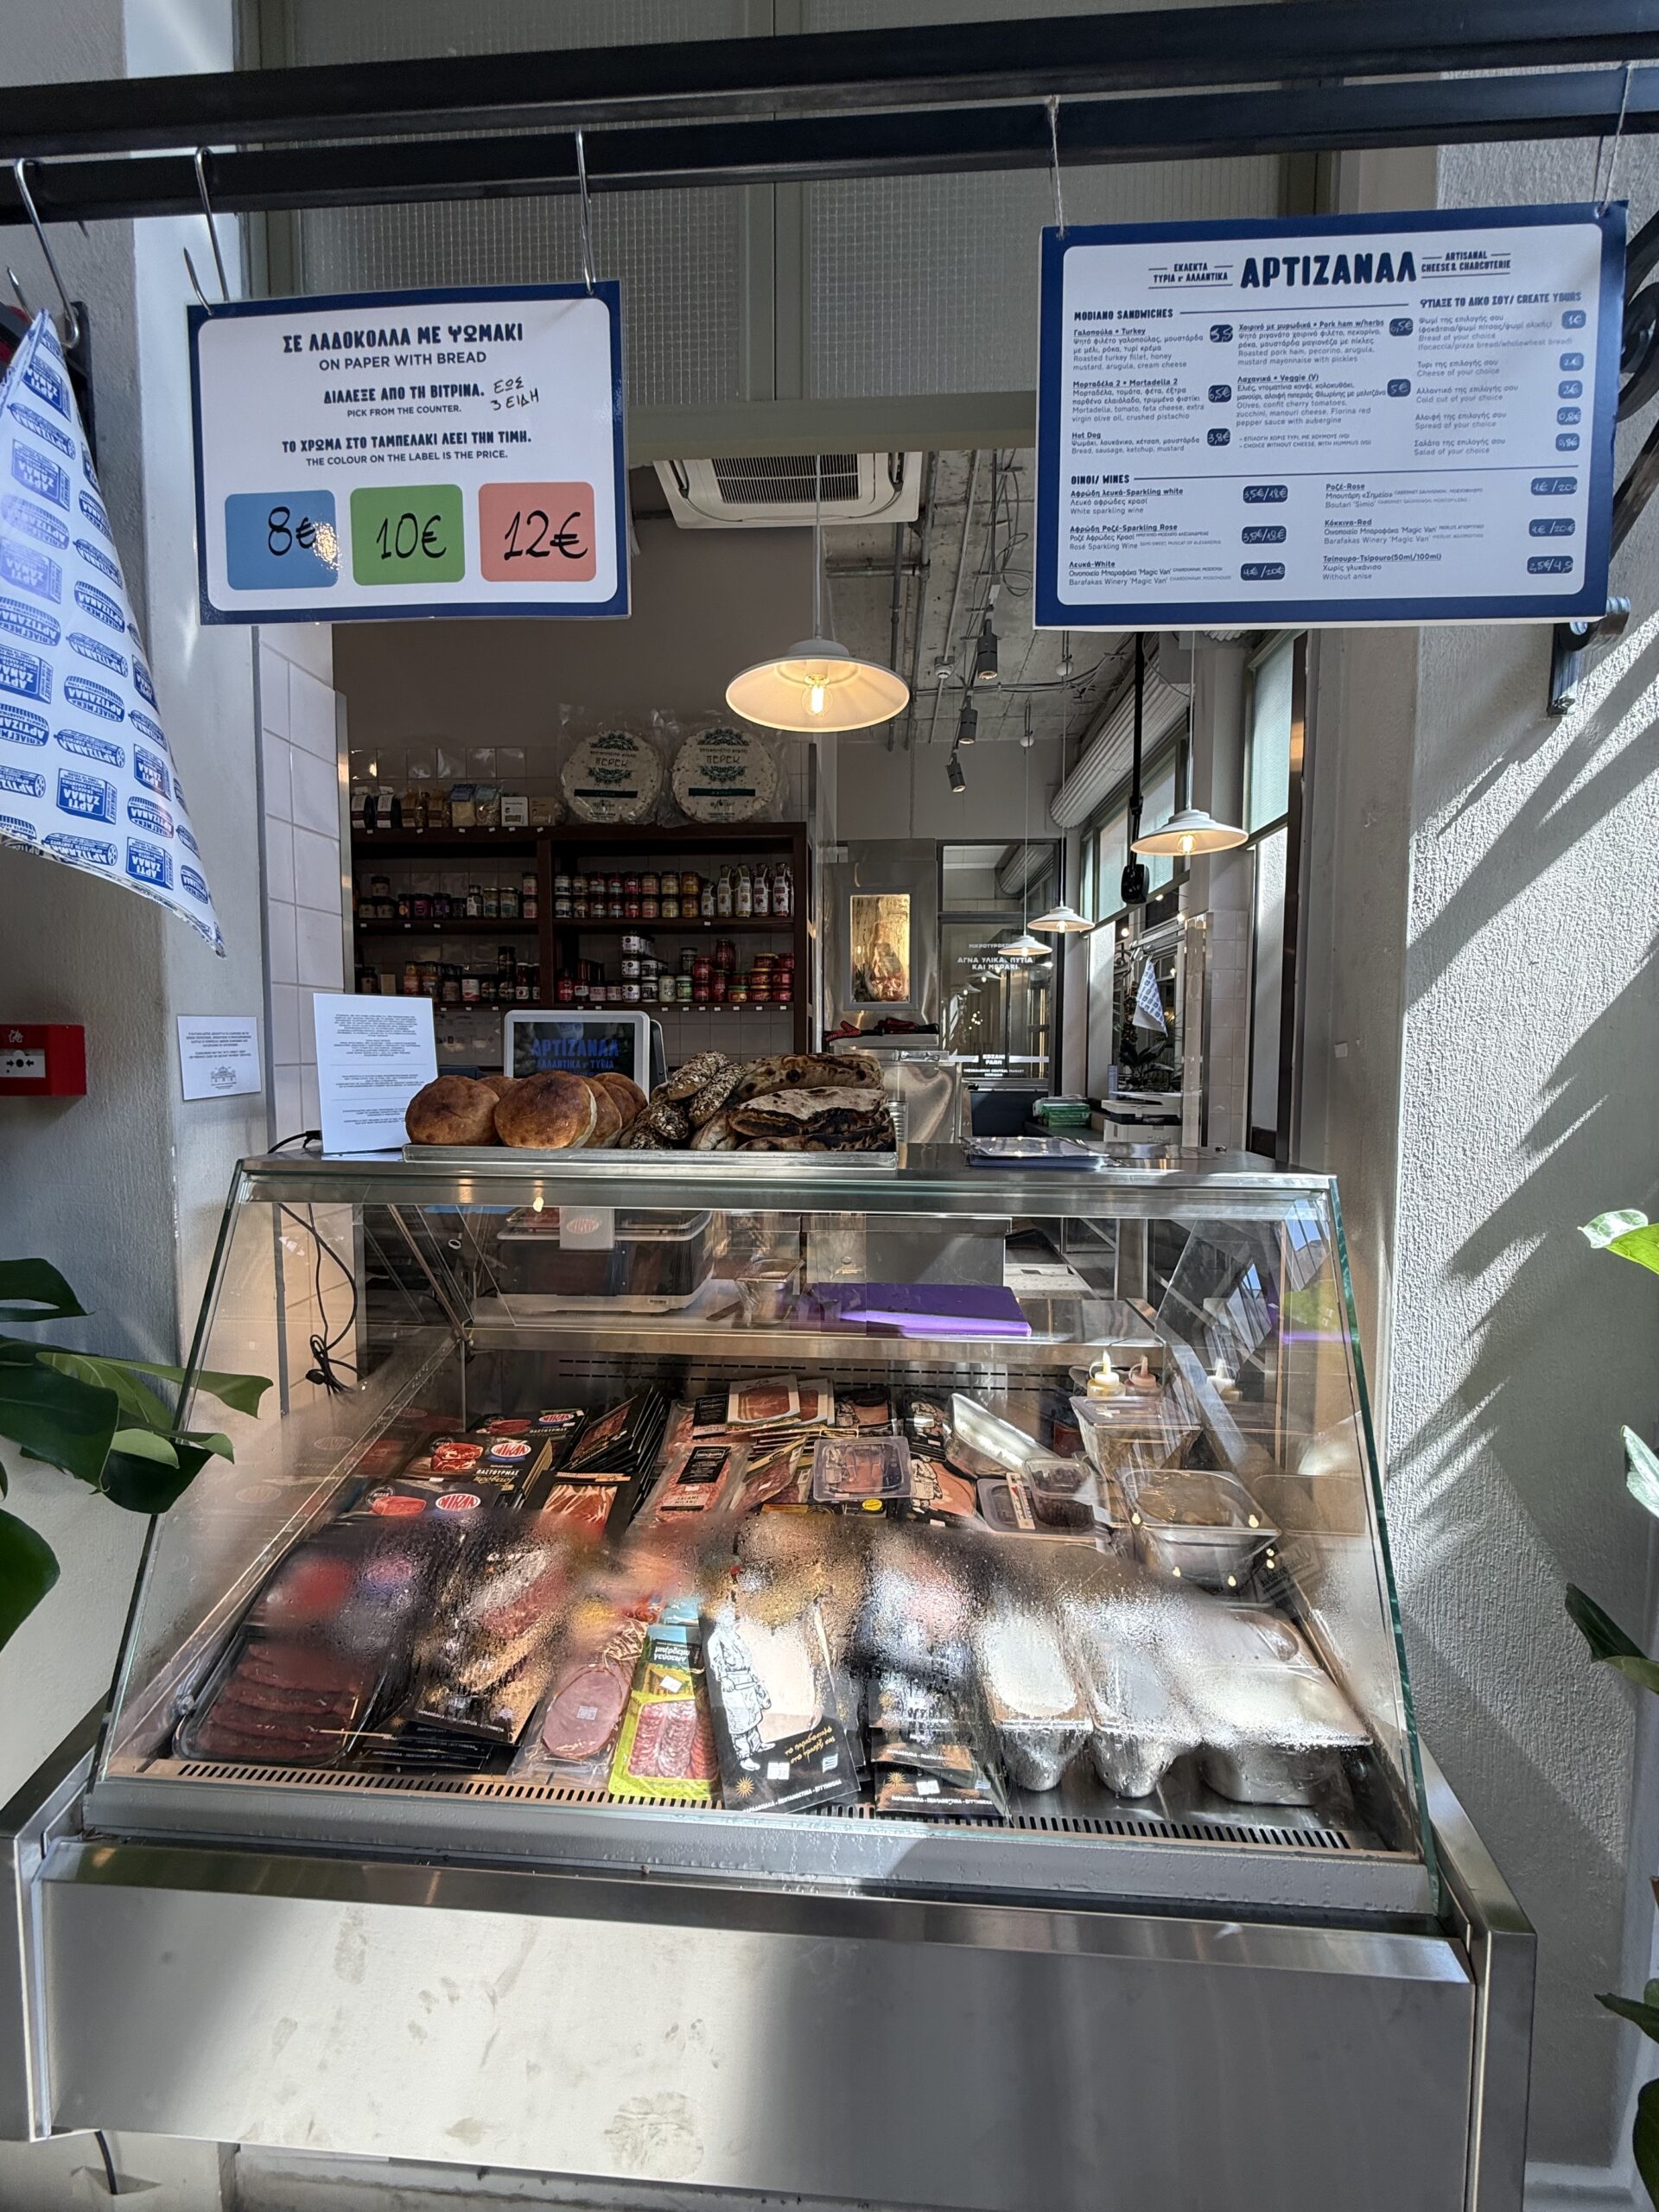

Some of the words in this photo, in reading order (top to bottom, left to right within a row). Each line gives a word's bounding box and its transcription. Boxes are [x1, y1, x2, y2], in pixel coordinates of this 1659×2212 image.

[1446, 251, 1487, 261] ARTISANAL
[1174, 263, 1208, 272] ΕΚΛΕΚΤΑ
[1240, 251, 1417, 289] ΑΡΤΙΖΑΝΑΛ
[1421, 263, 1450, 272] CHEESE
[1459, 260, 1510, 270] CHARCUTERIE
[1154, 274, 1175, 283] ΤΥΡΙΑ
[1186, 272, 1228, 282] ΑΛΛΑΝΤΙΚΑ
[1074, 311, 1114, 321] MODIANO
[1117, 308, 1173, 319] SANDWICHES
[283, 335, 302, 353] ΣΕ
[309, 329, 410, 352] ΛΑΔΟΚΟΛΛΑ
[417, 327, 442, 346] ΜΕ
[448, 323, 523, 344] ΨΩΜΑΚΙ
[319, 359, 340, 371] ON
[345, 356, 391, 369] PAPER
[395, 353, 434, 366] WITH
[437, 351, 486, 365] BREAD
[1151, 353, 1172, 361] honey
[1073, 380, 1113, 389] Μορταδέλα
[323, 387, 376, 404] ΔΙΑΛΕΞΕ
[381, 386, 405, 402] ΑΠΟ
[410, 385, 426, 400] ΤΗ
[430, 383, 485, 399] ΒΙΤΡΙΝΑ.
[491, 398, 502, 411] 3
[505, 389, 539, 409] ΕΙΔΗ
[346, 409, 367, 418] PICK
[369, 407, 395, 416] FROM
[397, 406, 414, 416] THE
[416, 404, 462, 415] COUNTER.
[282, 440, 296, 454] ΤΟ
[301, 437, 342, 452] ΧΡΩΜΑ
[346, 436, 367, 450] ΣΤΟ
[371, 433, 438, 449] ΤΑΜΠΕΛΑΚΙ
[442, 432, 467, 446] ΛΕΕΙ
[472, 431, 494, 445] ΤΗΝ
[498, 429, 532, 443] ΤΙΜΗ.
[306, 457, 324, 467] THE
[327, 454, 367, 466] COLOUR
[370, 454, 385, 463] ON
[387, 453, 405, 463] THE
[409, 451, 440, 462] LABEL
[443, 451, 451, 461] IS
[454, 450, 474, 461] THE
[476, 448, 508, 460] PRICE.
[1071, 475, 1099, 485] ΟΙΝΟΙ/
[1103, 474, 1129, 484] WINES
[267, 505, 316, 557] 8€
[376, 512, 447, 560] 10€
[503, 510, 588, 561] 12€
[67, 687, 123, 715] ΑΡΤΙΖΑΝΑΛ
[63, 788, 100, 805] ΖΑΝΑΛ
[68, 798, 94, 812] ΑΡΤΙ
[130, 855, 162, 872] ΖΑΝΑΛ
[136, 865, 157, 878] ΑΡΤΙ
[494, 1444, 530, 1456] MIRAN
[438, 1495, 479, 1510] MIRAN
